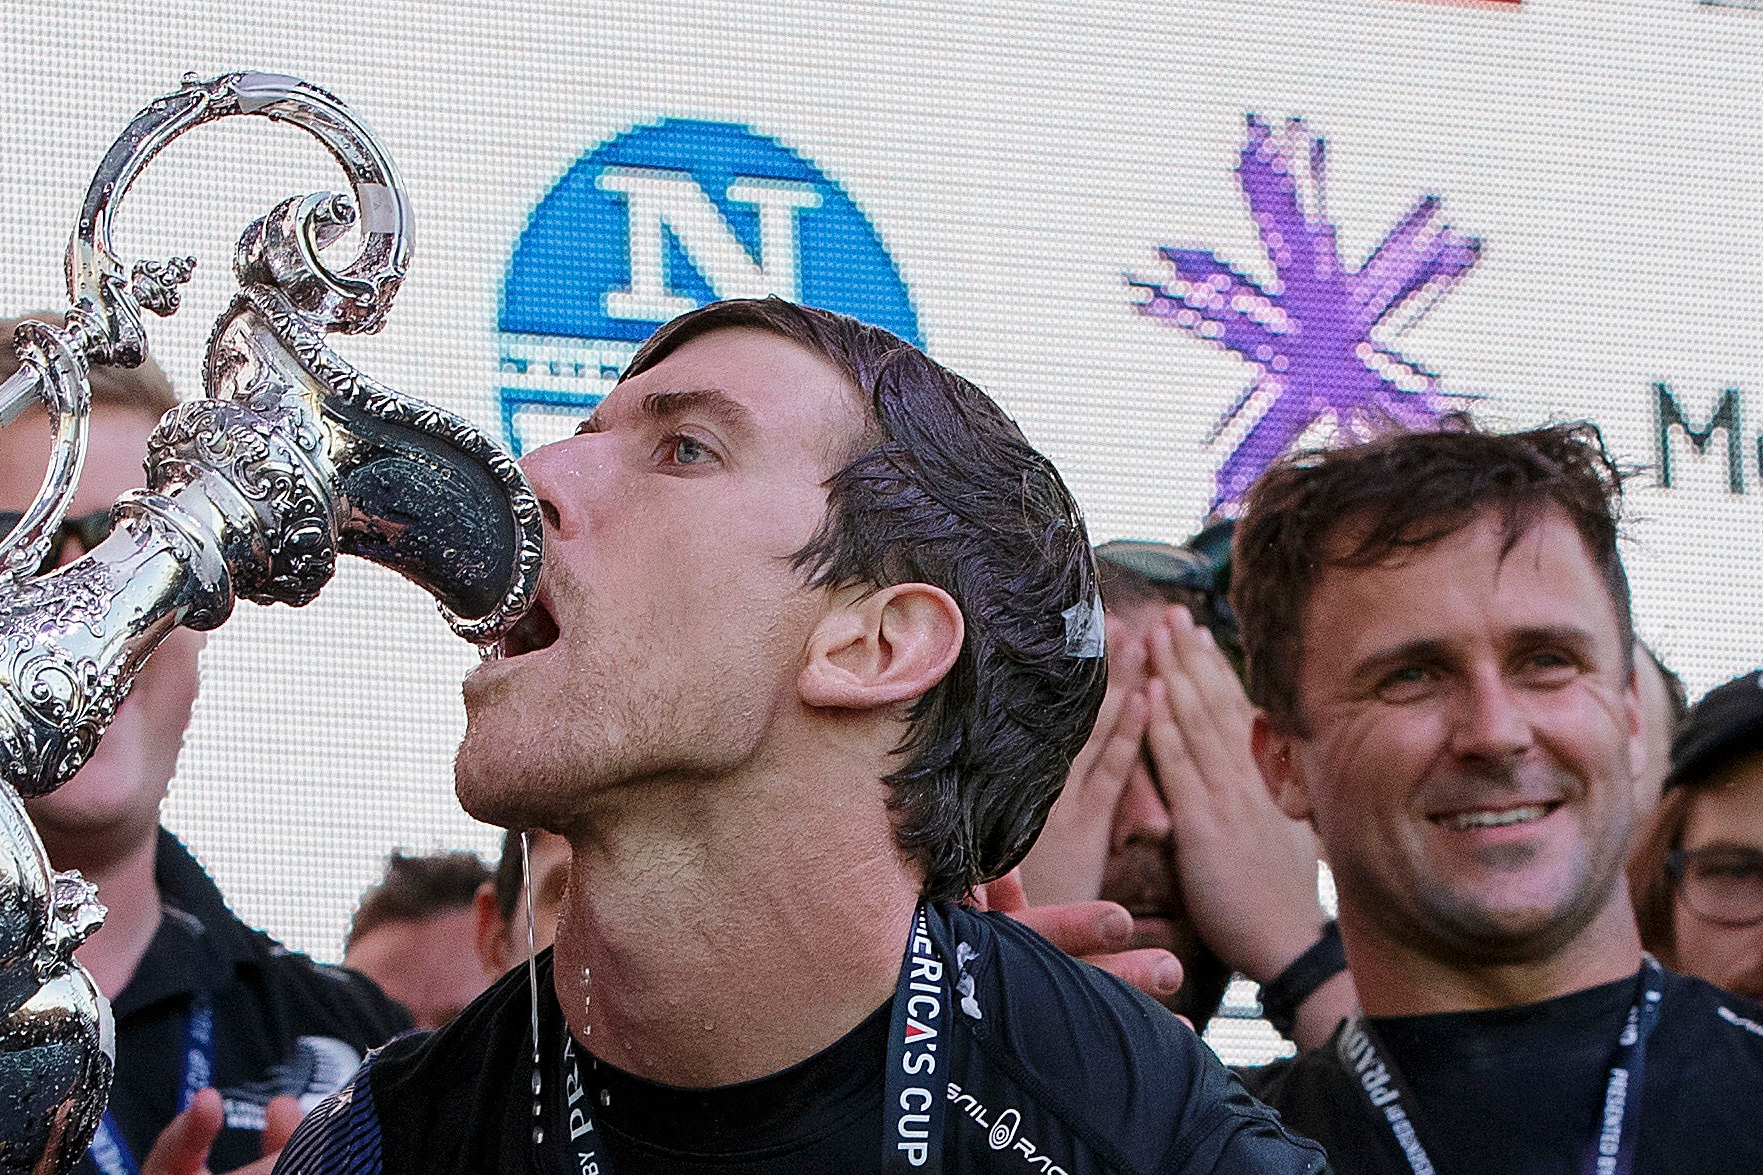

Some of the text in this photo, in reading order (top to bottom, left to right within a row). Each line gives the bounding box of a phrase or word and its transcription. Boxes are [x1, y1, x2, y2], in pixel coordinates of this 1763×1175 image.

[1652, 381, 1763, 494] M
[897, 1087, 933, 1166] CUP
[947, 1082, 989, 1128] SAIL
